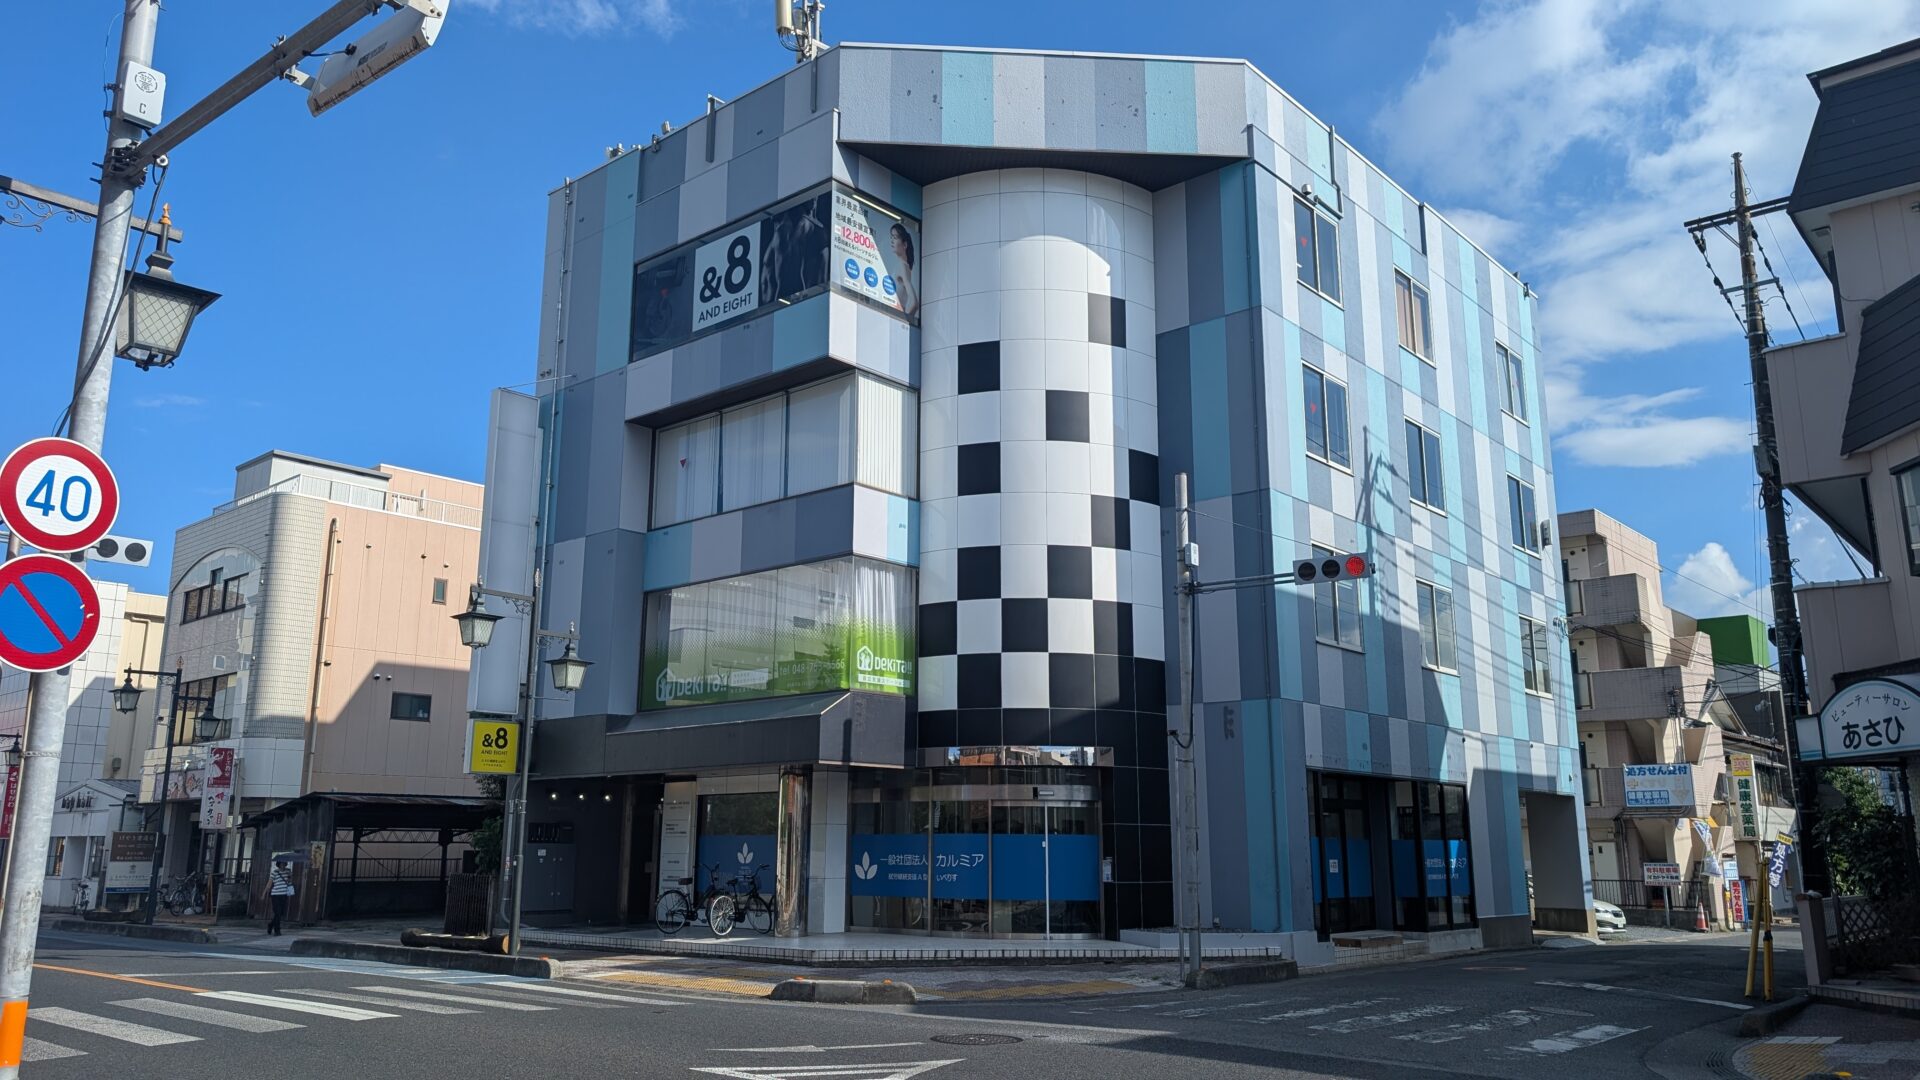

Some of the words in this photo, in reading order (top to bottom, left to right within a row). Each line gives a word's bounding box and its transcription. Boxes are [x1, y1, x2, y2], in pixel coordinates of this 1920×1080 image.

[699, 235, 752, 304] &8
[698, 305, 720, 323] AND
[723, 292, 752, 314] EIGHT
[26, 469, 92, 522] 40
[1831, 693, 1911, 722] ビューティーサロン
[482, 727, 508, 749] &8
[1841, 716, 1905, 750] あさひ
[1626, 765, 1688, 777] 処方せん受付
[1738, 779, 1756, 837] 健康堂薬局
[880, 854, 928, 866] 一般社団法人
[935, 853, 984, 868] カルミア
[1769, 843, 1786, 888] 処方箋
